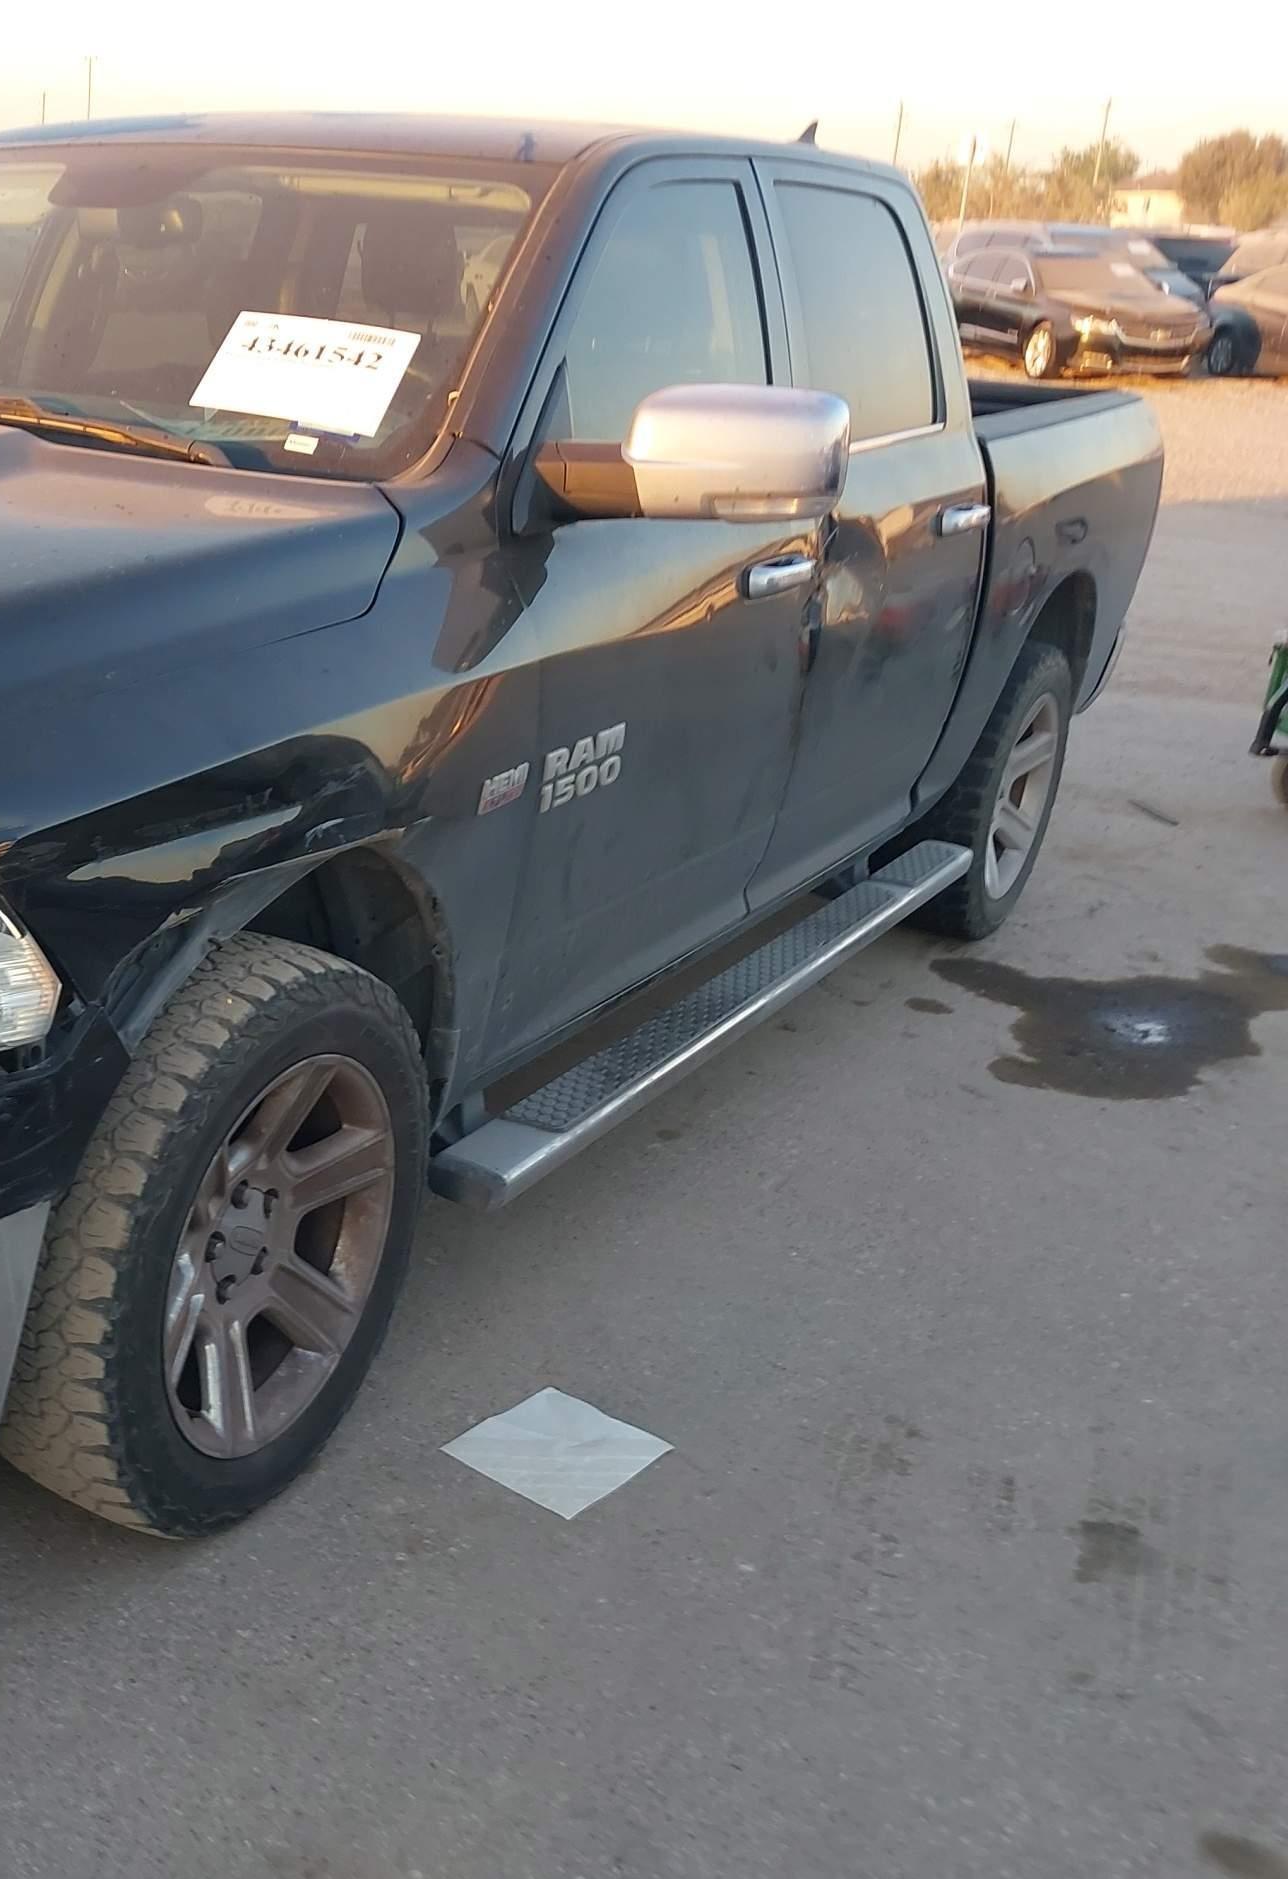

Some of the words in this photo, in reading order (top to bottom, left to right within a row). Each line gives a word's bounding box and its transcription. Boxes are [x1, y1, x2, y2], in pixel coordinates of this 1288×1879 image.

[240, 335, 384, 371] 43461542
[542, 721, 627, 783] RAM
[538, 754, 622, 815] 1500
